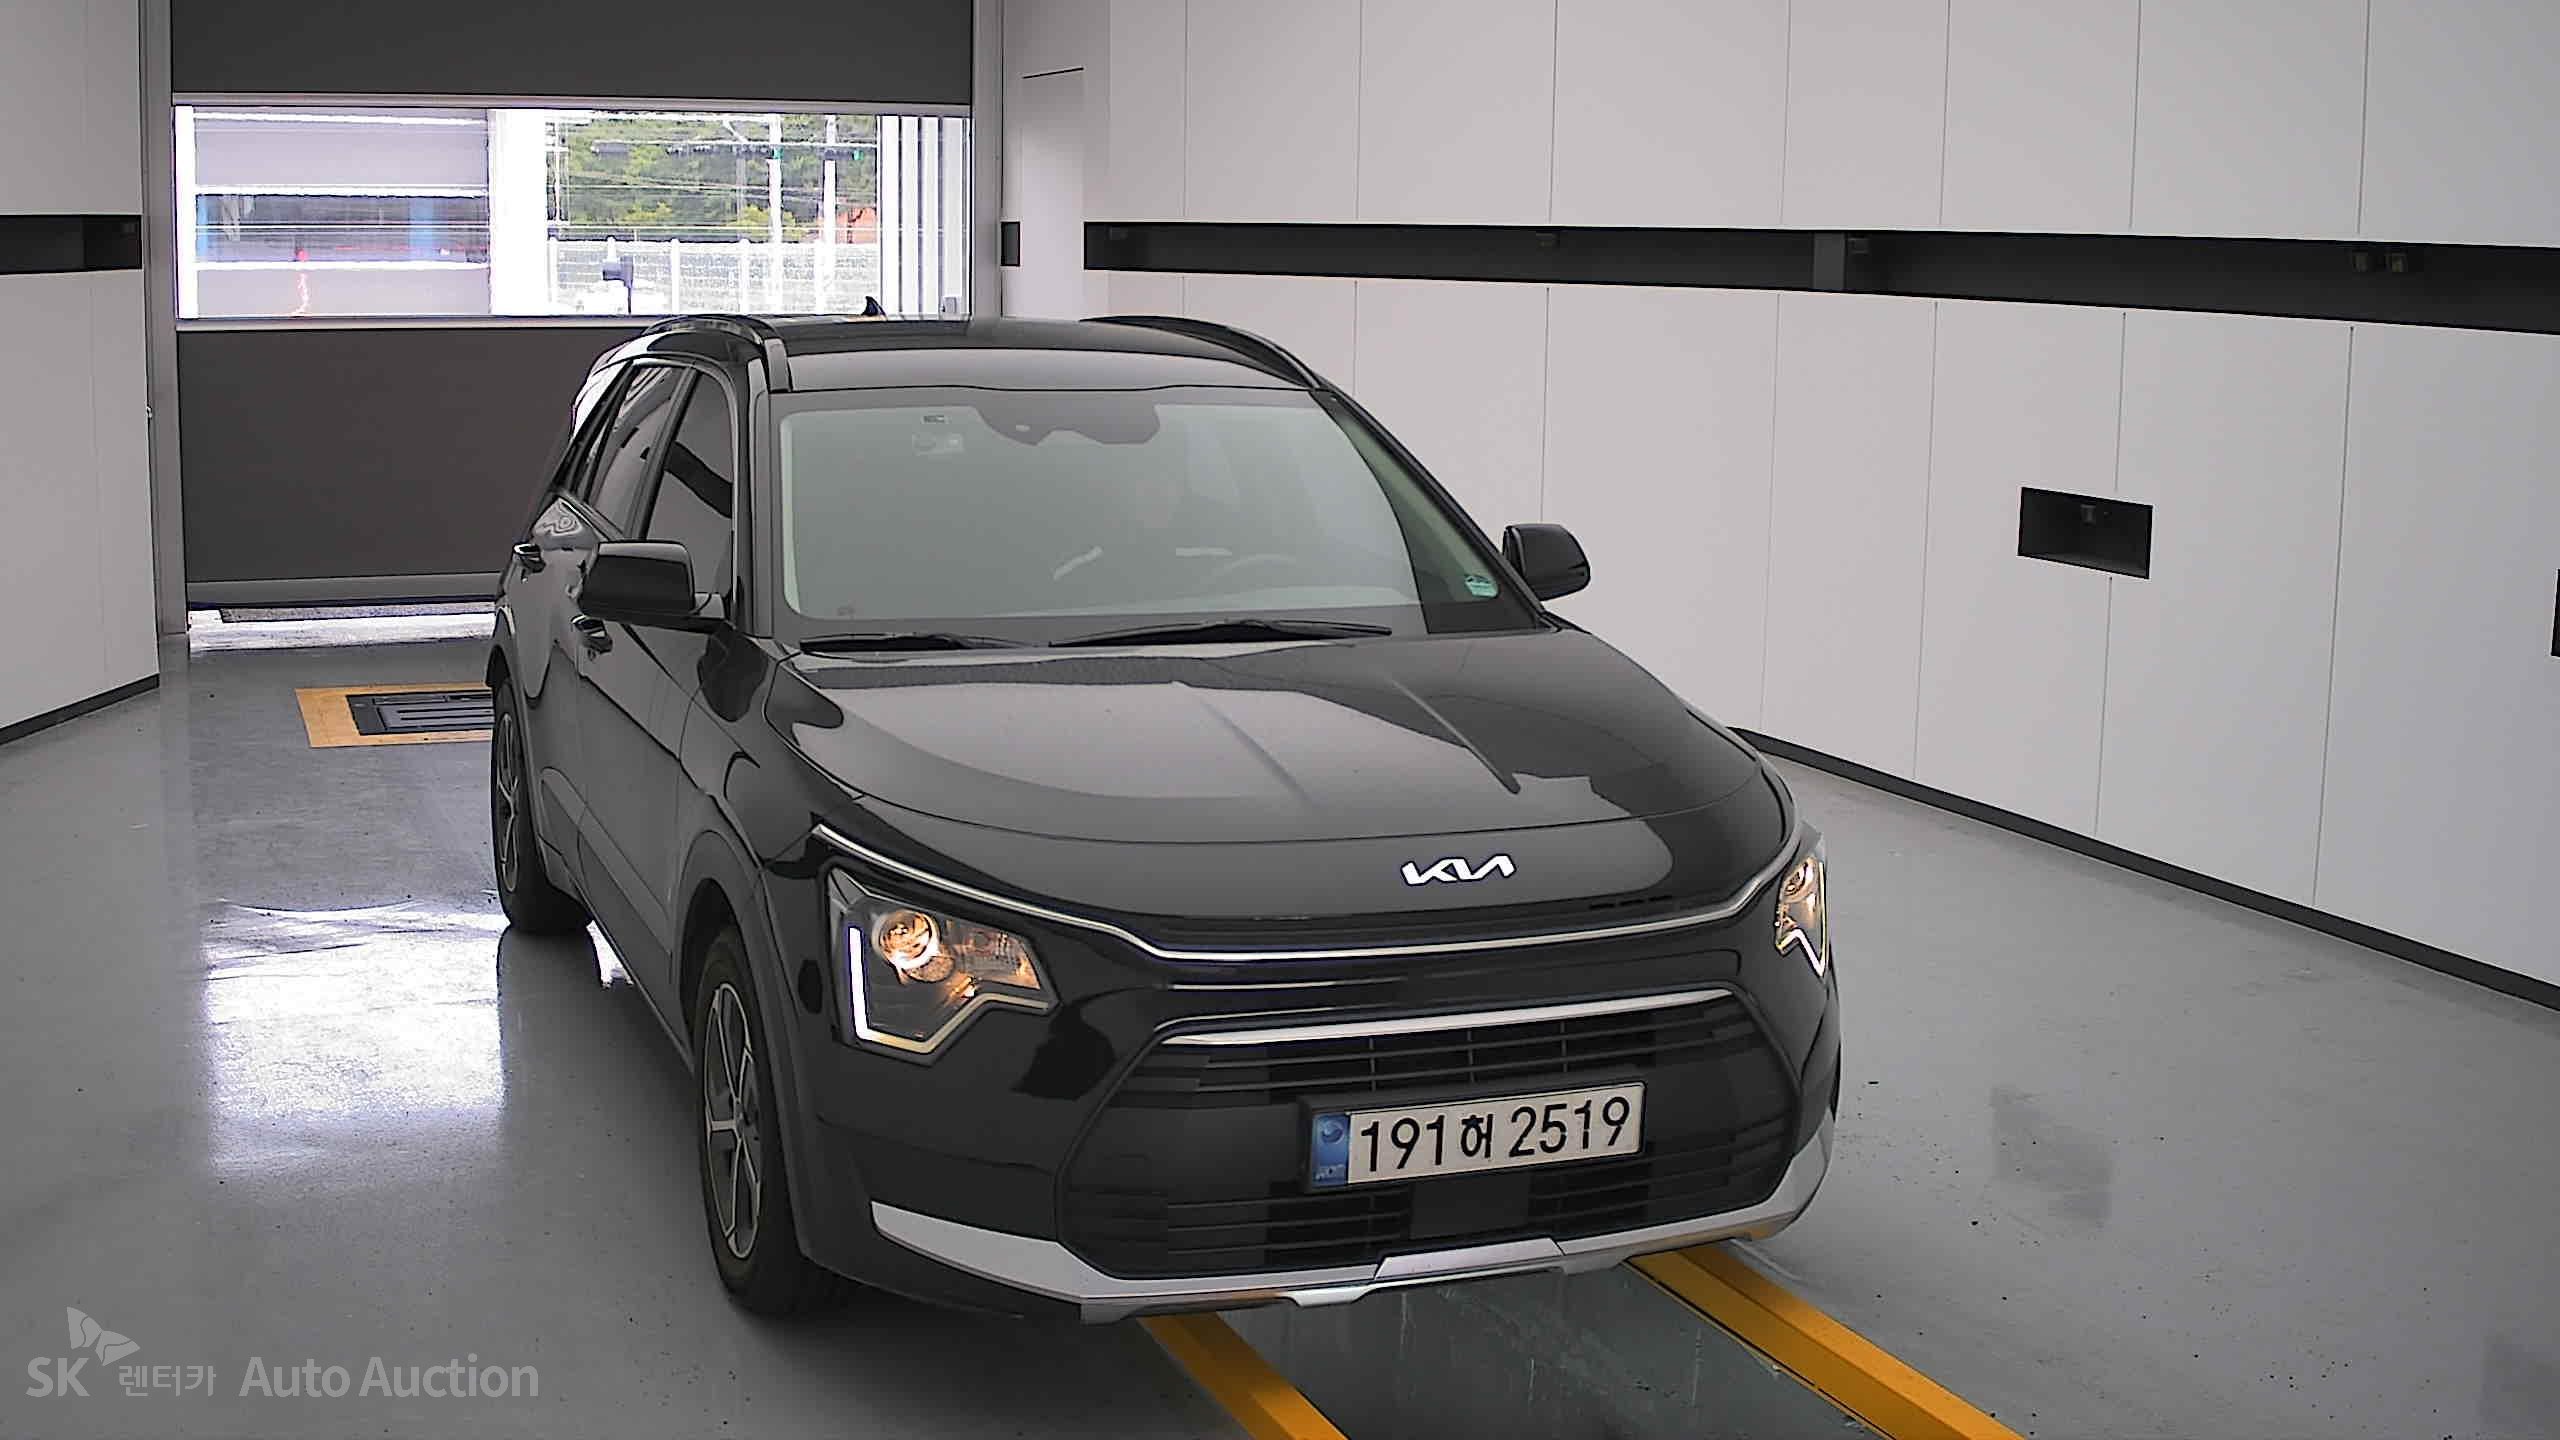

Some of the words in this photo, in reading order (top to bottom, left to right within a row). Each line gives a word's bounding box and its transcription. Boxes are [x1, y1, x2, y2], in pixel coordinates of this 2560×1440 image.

[1401, 853, 1517, 887] KIA
[1360, 1112, 1495, 1173] 191허
[1507, 1095, 1631, 1159] 2519
